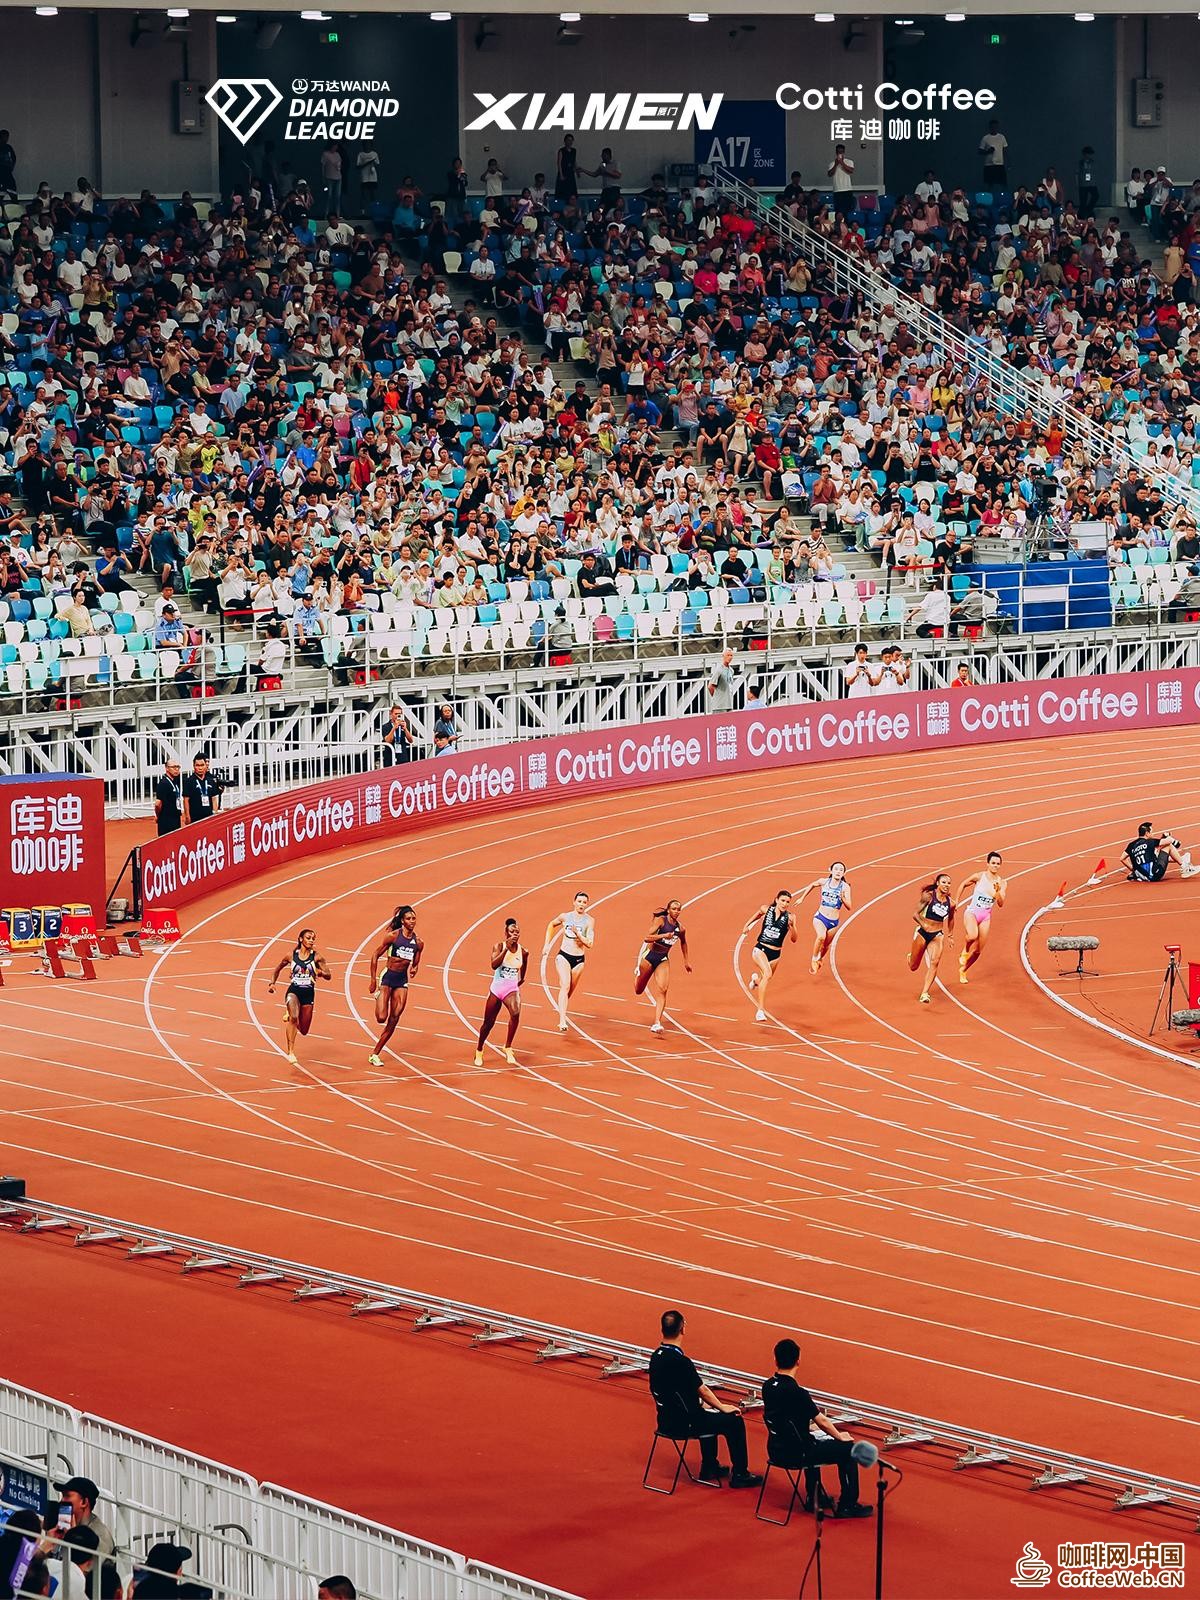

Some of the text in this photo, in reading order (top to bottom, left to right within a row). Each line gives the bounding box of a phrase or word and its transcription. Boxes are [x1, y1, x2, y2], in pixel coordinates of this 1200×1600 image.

[707, 136, 751, 168] A17
[753, 148, 762, 158] 区
[753, 158, 775, 168] ZONE
[1157, 680, 1182, 698] 库迪
[926, 700, 950, 717] 库迪
[960, 687, 1139, 732] Cotti Coffee
[746, 709, 910, 757] Cotti Coffee
[555, 734, 701, 785] Cotti Coffee
[388, 762, 515, 818] Cotti Coffee
[10, 793, 83, 836] 库迪
[250, 796, 354, 857] Cotti Coffee
[11, 834, 84, 875] 咖啡
[1136, 854, 1146, 865] 01
[144, 837, 225, 902] Cotti Coffee
[19, 921, 27, 932] 3
[49, 919, 57, 930] 2
[157, 927, 179, 935] OMEGA
[9, 1488, 17, 1499] No
